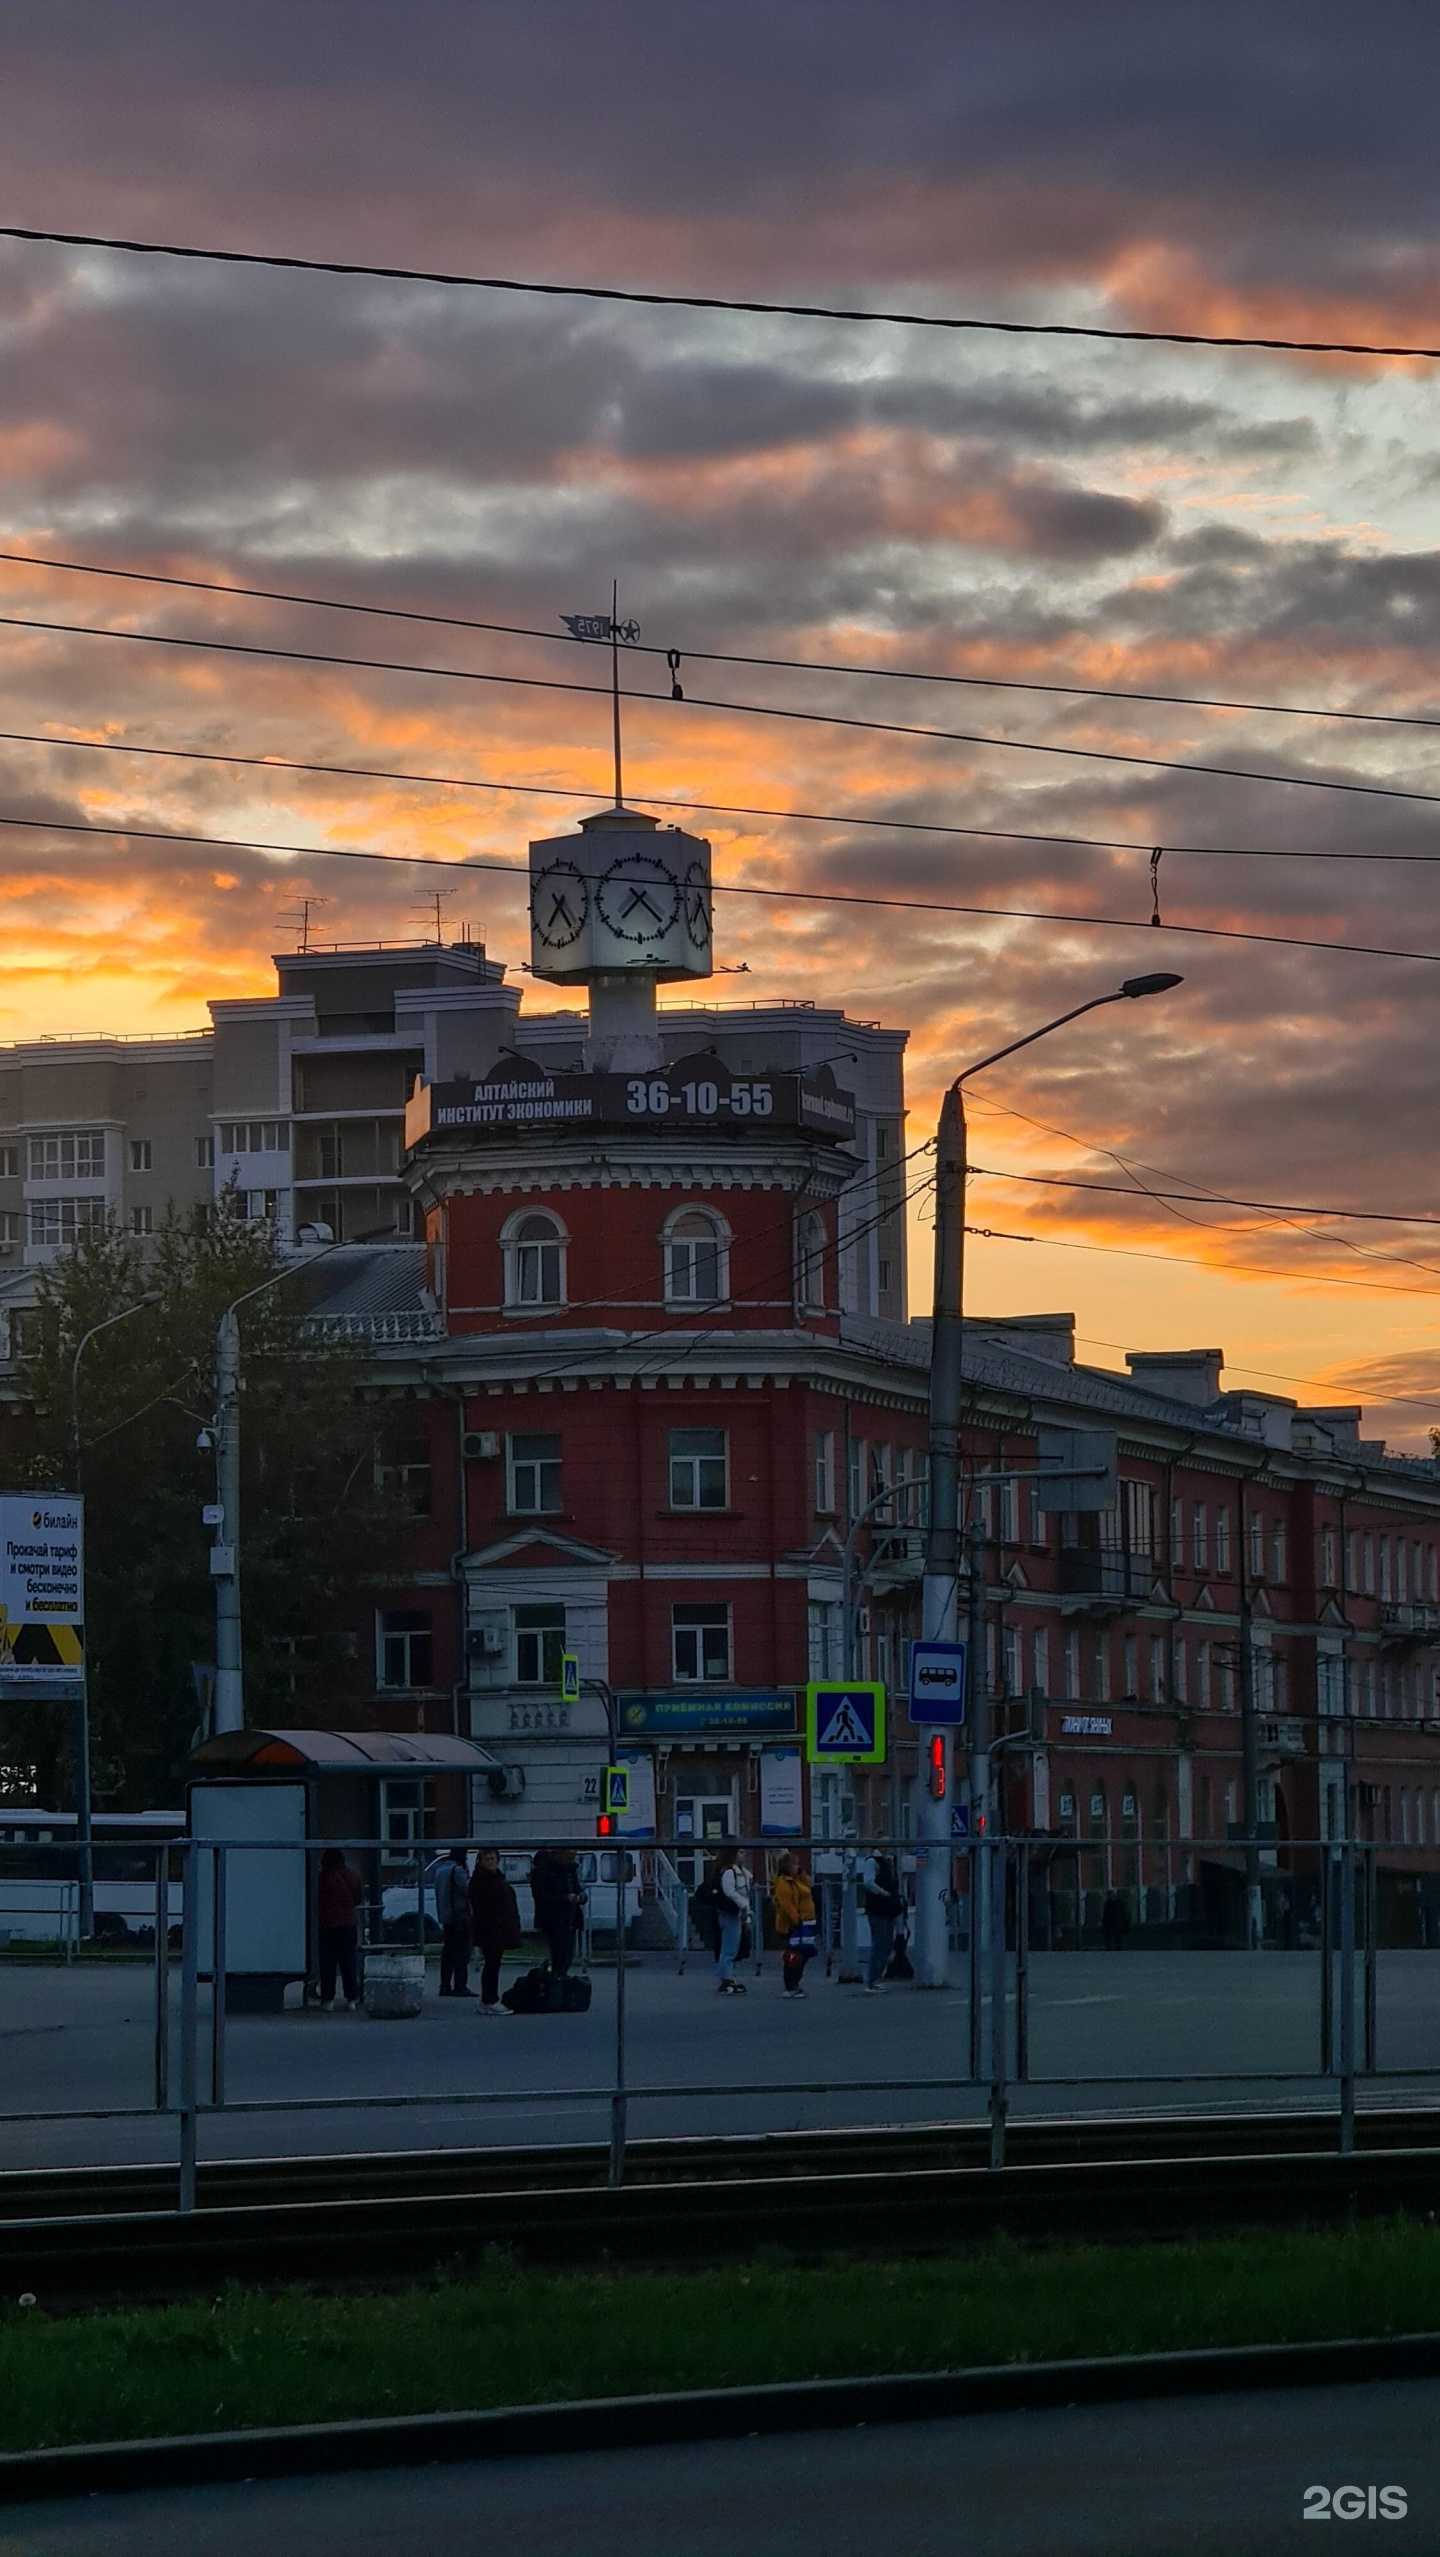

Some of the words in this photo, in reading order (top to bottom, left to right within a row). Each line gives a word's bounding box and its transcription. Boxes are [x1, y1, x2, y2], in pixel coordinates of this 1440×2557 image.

[473, 1079, 555, 1102] АЛТАЙСКИЙ
[626, 1080, 773, 1116] 36-10-55
[437, 1104, 505, 1124] ИНСТИТУТ
[507, 1099, 593, 1120] ЭКОНОМИКИ
[43, 1511, 78, 1529] билайн
[7, 1541, 48, 1560] Прокачай
[50, 1543, 78, 1561] тариф
[10, 1564, 17, 1574] и
[18, 1564, 50, 1578] смотри
[52, 1564, 78, 1578] видео
[27, 1578, 78, 1594] бесконечно
[584, 1777, 597, 1794] 22
